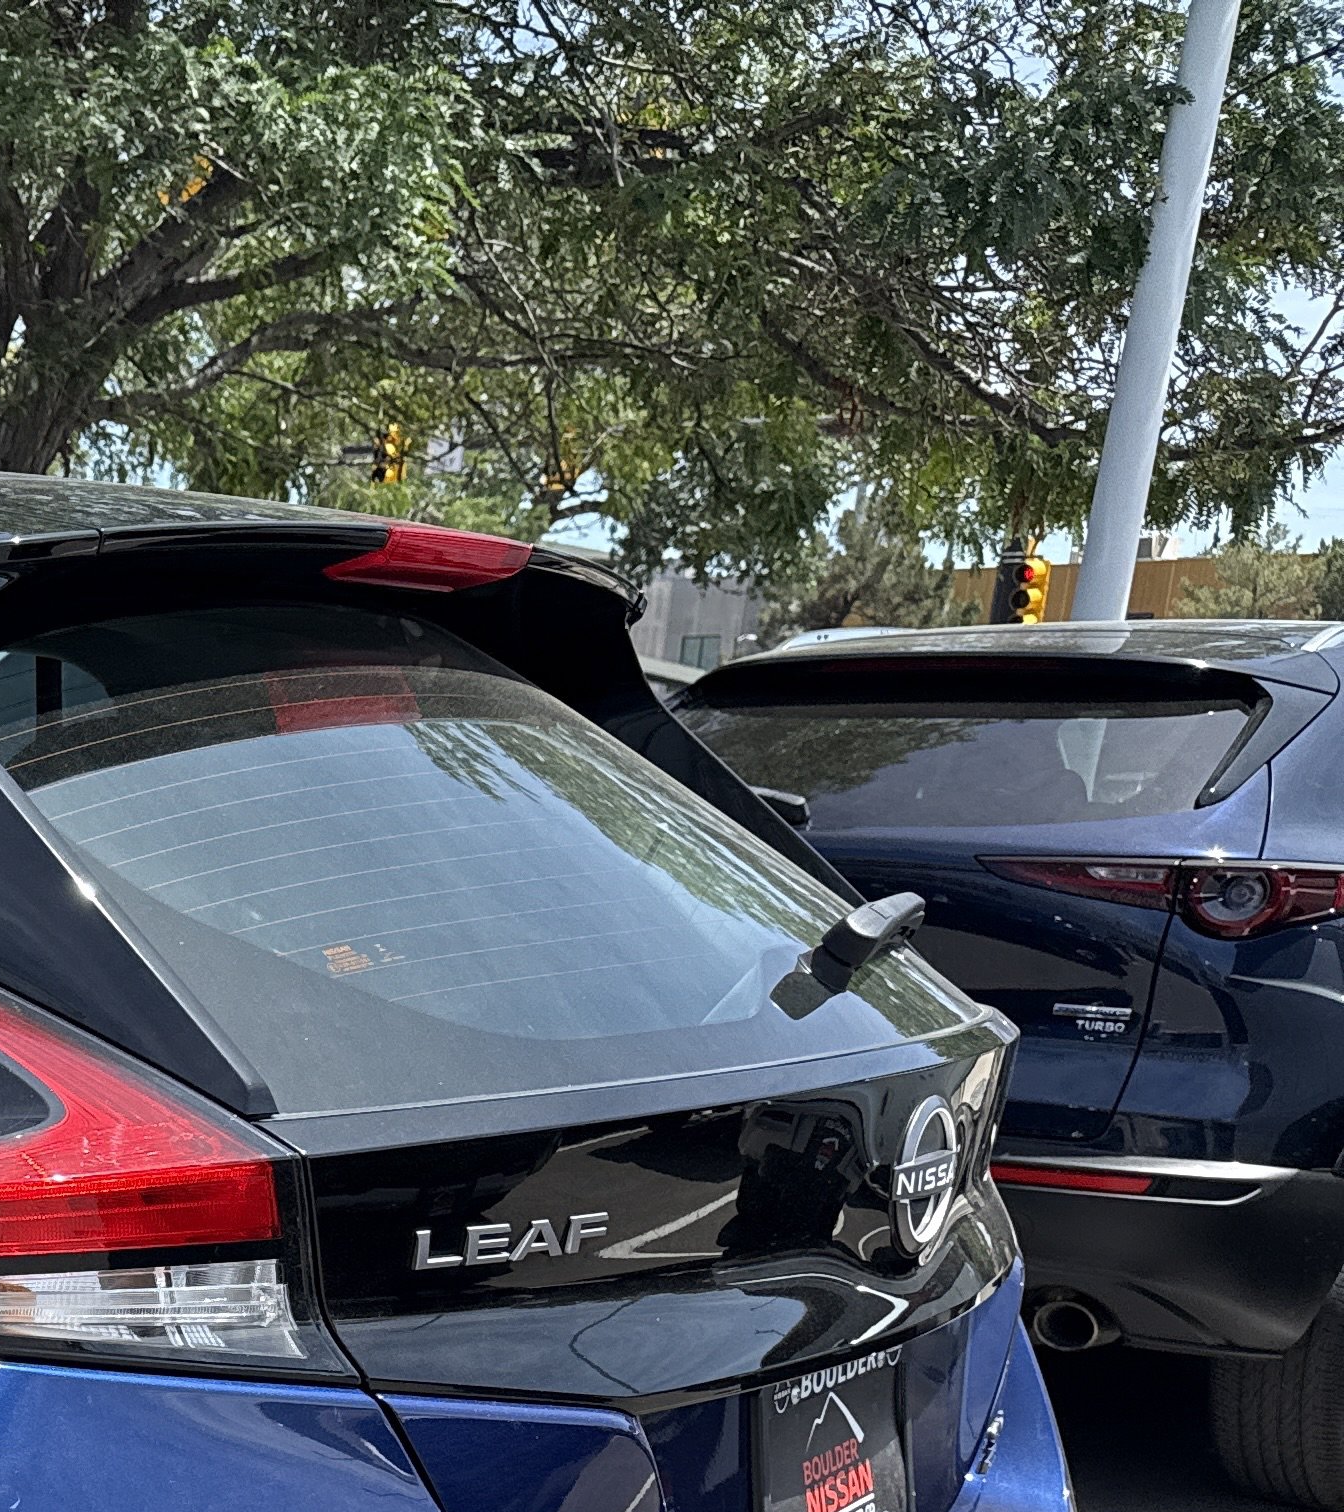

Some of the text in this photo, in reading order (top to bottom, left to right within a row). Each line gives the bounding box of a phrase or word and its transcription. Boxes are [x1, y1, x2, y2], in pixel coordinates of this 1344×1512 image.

[1075, 1019, 1126, 1033] TURBO
[896, 1161, 955, 1196] NISSA
[414, 1211, 610, 1271] LEAF
[800, 1352, 878, 1399] BOULDER
[802, 1437, 860, 1486] BOULDER
